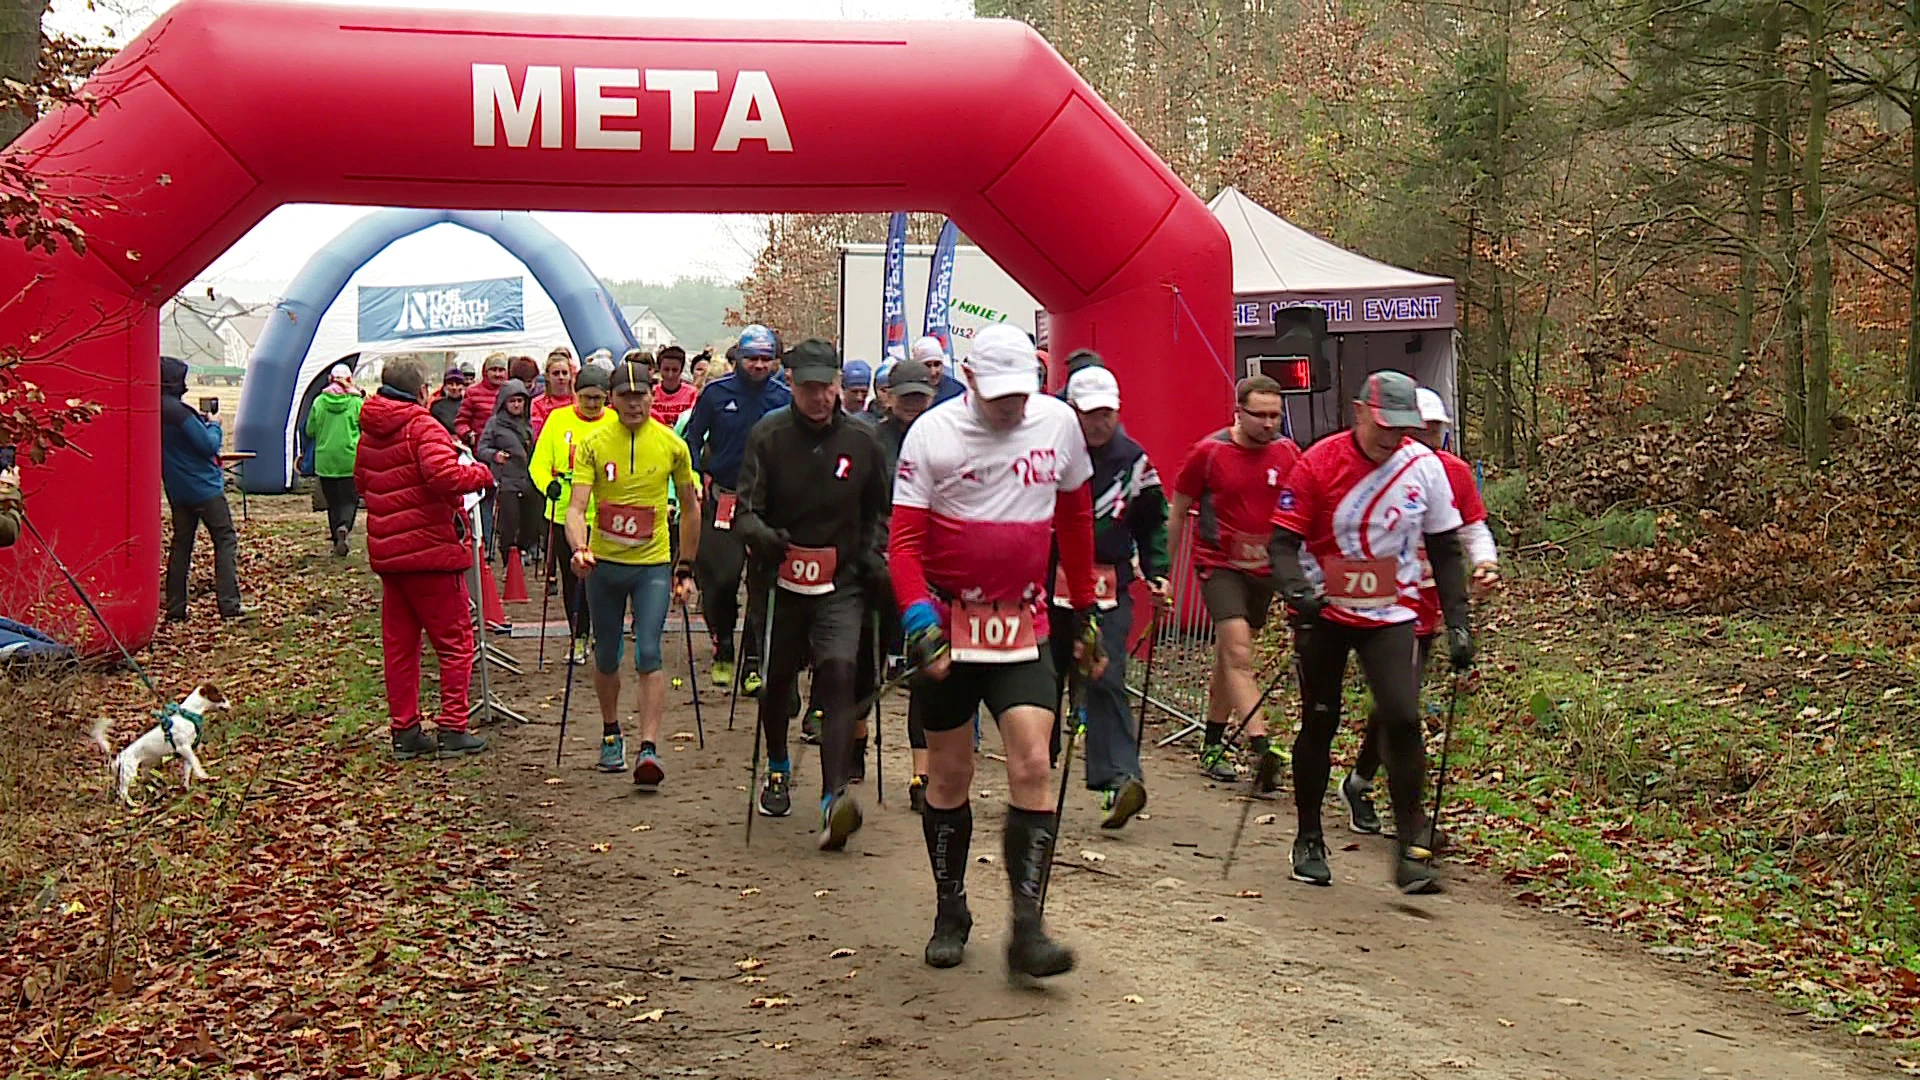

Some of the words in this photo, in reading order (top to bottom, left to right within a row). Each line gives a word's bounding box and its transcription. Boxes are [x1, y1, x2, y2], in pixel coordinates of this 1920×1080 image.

[471, 63, 794, 152] META
[427, 289, 461, 302] THE
[430, 297, 489, 315] NORTH
[430, 309, 486, 329] EVENT
[1233, 303, 1259, 326] HE
[1363, 295, 1442, 321] EVENT
[611, 514, 637, 535] 86
[791, 560, 820, 581] 90
[1343, 572, 1377, 594] 70
[969, 616, 1021, 646] 107
